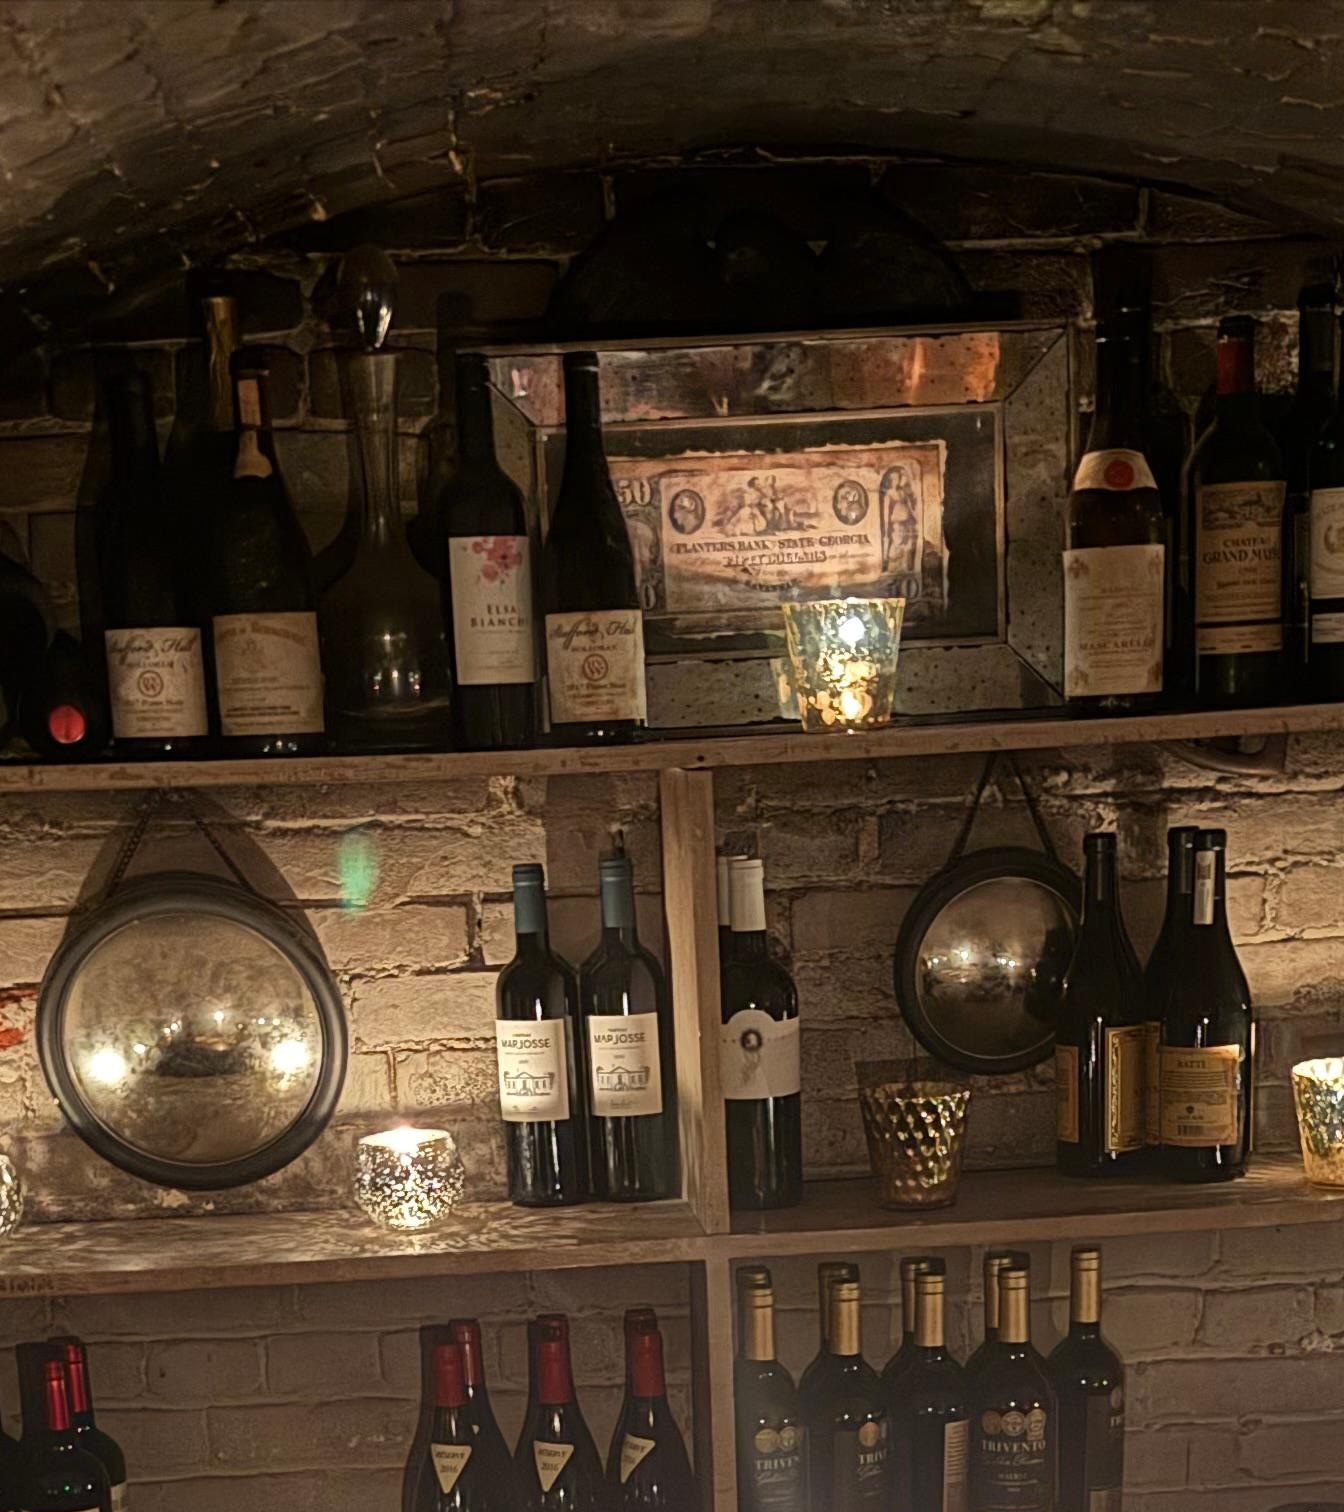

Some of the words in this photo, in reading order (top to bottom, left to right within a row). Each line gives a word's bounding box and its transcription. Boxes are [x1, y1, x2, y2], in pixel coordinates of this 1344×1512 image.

[675, 541, 737, 554] PLANTERS
[738, 539, 769, 551] BANK
[778, 538, 814, 549] STATE
[819, 535, 871, 547] GEORGIA
[1203, 549, 1248, 563] GRAND
[487, 604, 517, 615] ELSA
[980, 1440, 1047, 1453] TRIVENTO
[540, 1461, 560, 1473] 2016
